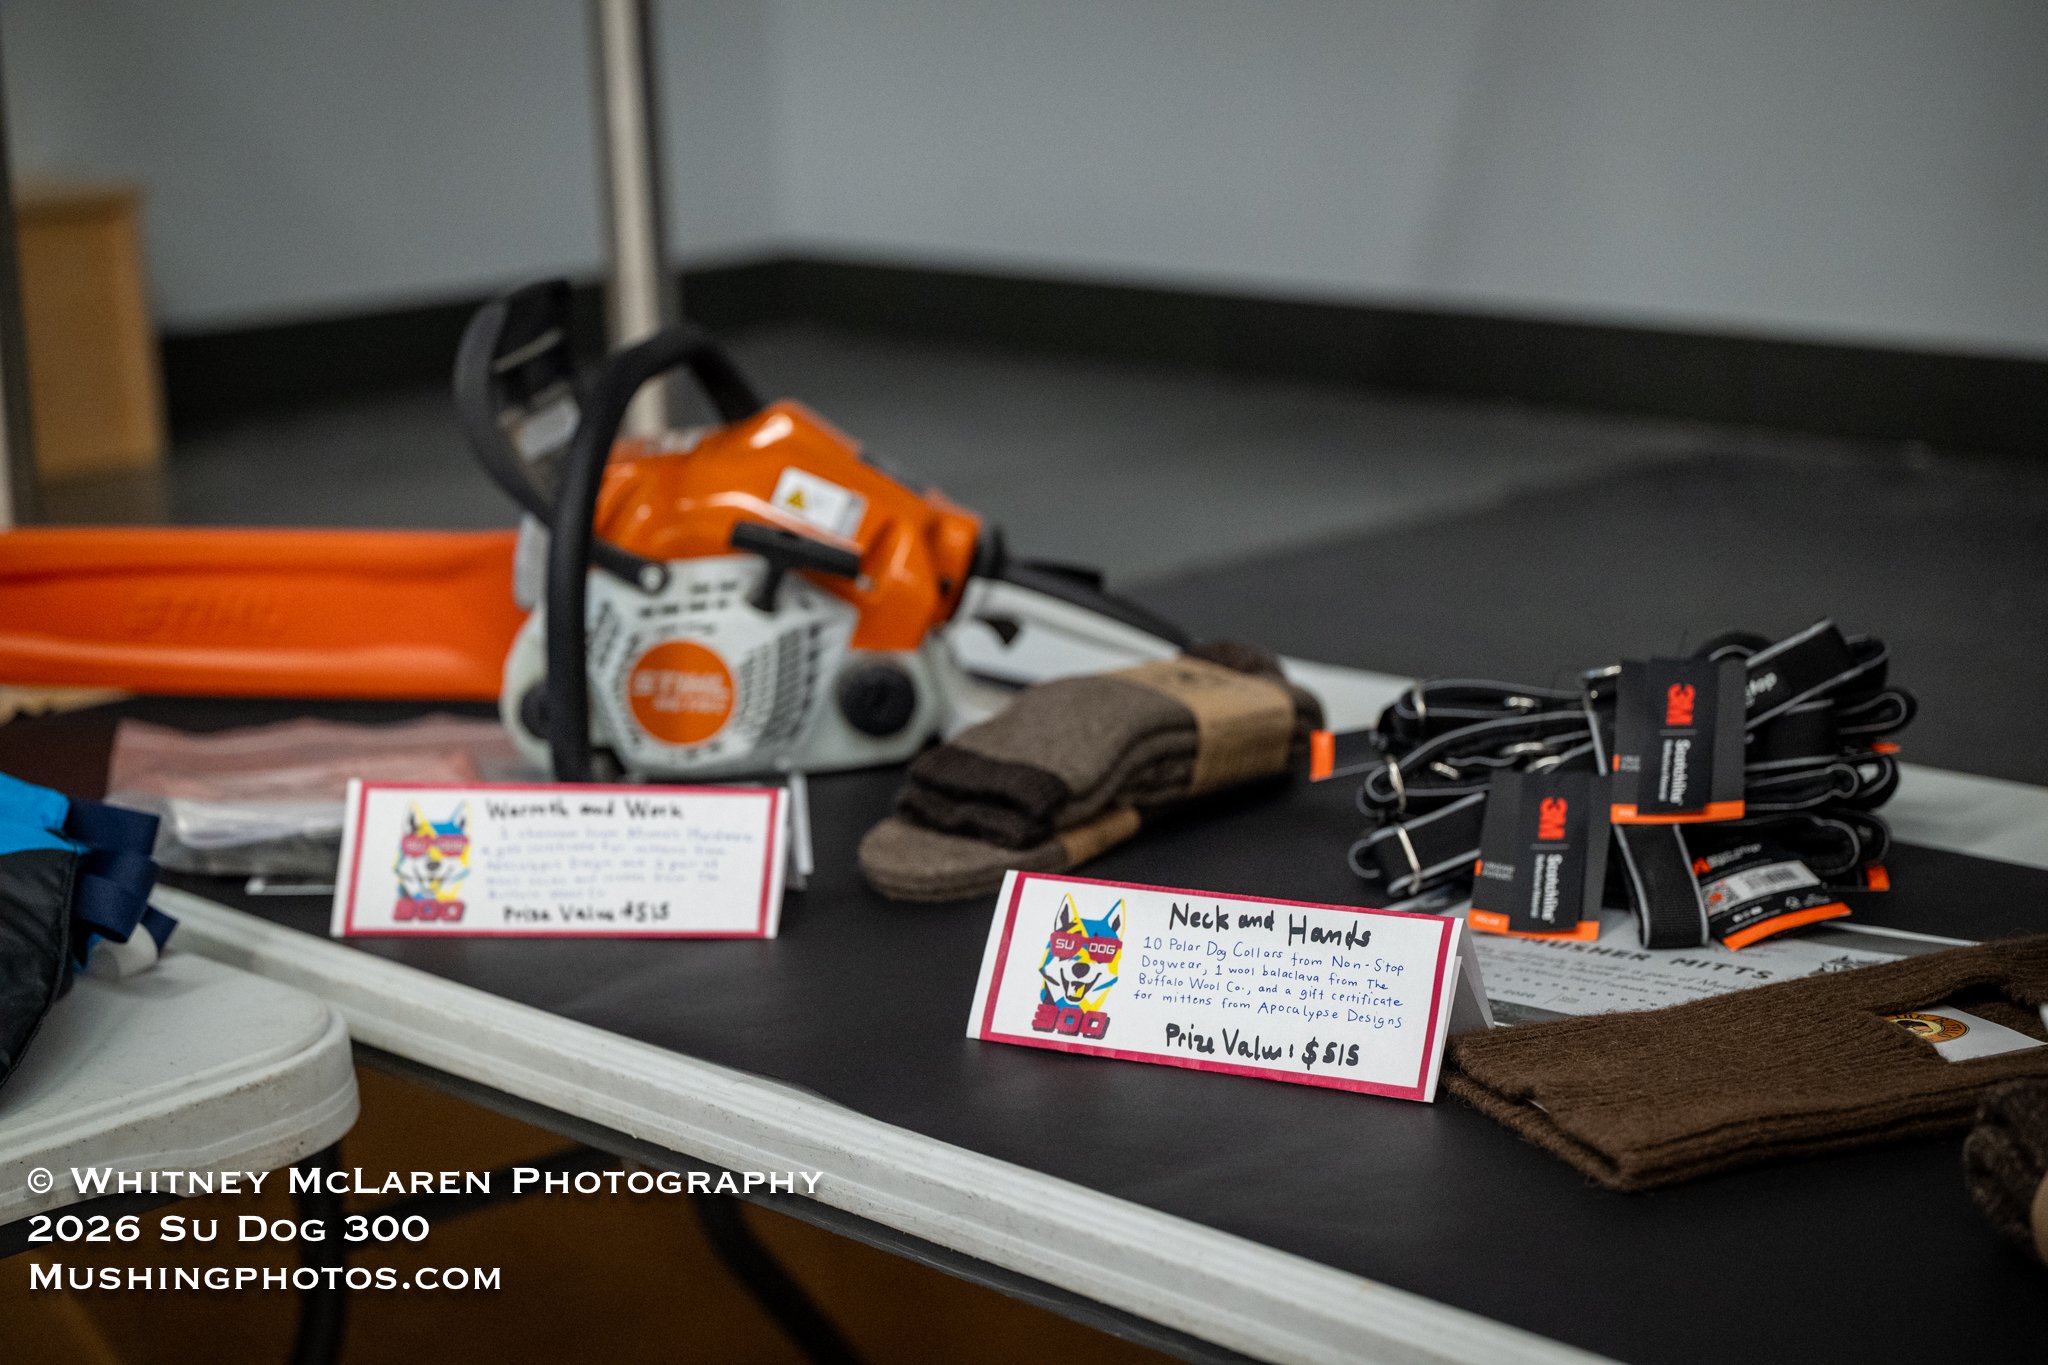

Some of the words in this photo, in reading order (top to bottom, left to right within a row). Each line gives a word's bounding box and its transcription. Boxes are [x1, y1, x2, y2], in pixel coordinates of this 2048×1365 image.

[1666, 683, 1696, 726] 3M
[1538, 797, 1568, 840] 3M
[1169, 902, 1230, 932] Neck
[1238, 910, 1275, 931] and
[1288, 913, 1371, 950] Hands
[1055, 938, 1075, 950] SU
[1088, 942, 1116, 955] DOG
[1143, 936, 1162, 950] 10
[1169, 938, 1201, 951] Polar
[1206, 941, 1227, 961] Dog
[1233, 941, 1283, 958] Collars
[1291, 952, 1322, 966] from
[1142, 955, 1208, 976] Dogwear,
[1215, 965, 1223, 975] 1
[1228, 966, 1255, 976] wool
[1262, 965, 1319, 983] balaclava
[1328, 972, 1358, 987] from
[1366, 978, 1389, 990] The
[1669, 958, 1773, 980] MITTS
[1139, 973, 1183, 986] Buffalo
[1189, 977, 1220, 991] Wool
[1258, 984, 1277, 993] and
[1298, 985, 1324, 1000] gift
[1331, 991, 1403, 1007] certificate
[1031, 1003, 1110, 1040] 300
[1133, 989, 1153, 1000] for
[1162, 993, 1212, 1005] mittens
[1221, 997, 1251, 1009] from
[1257, 1001, 1339, 1022] Apocalypse
[1347, 1008, 1402, 1028] Designs
[1166, 1022, 1215, 1054] Prize
